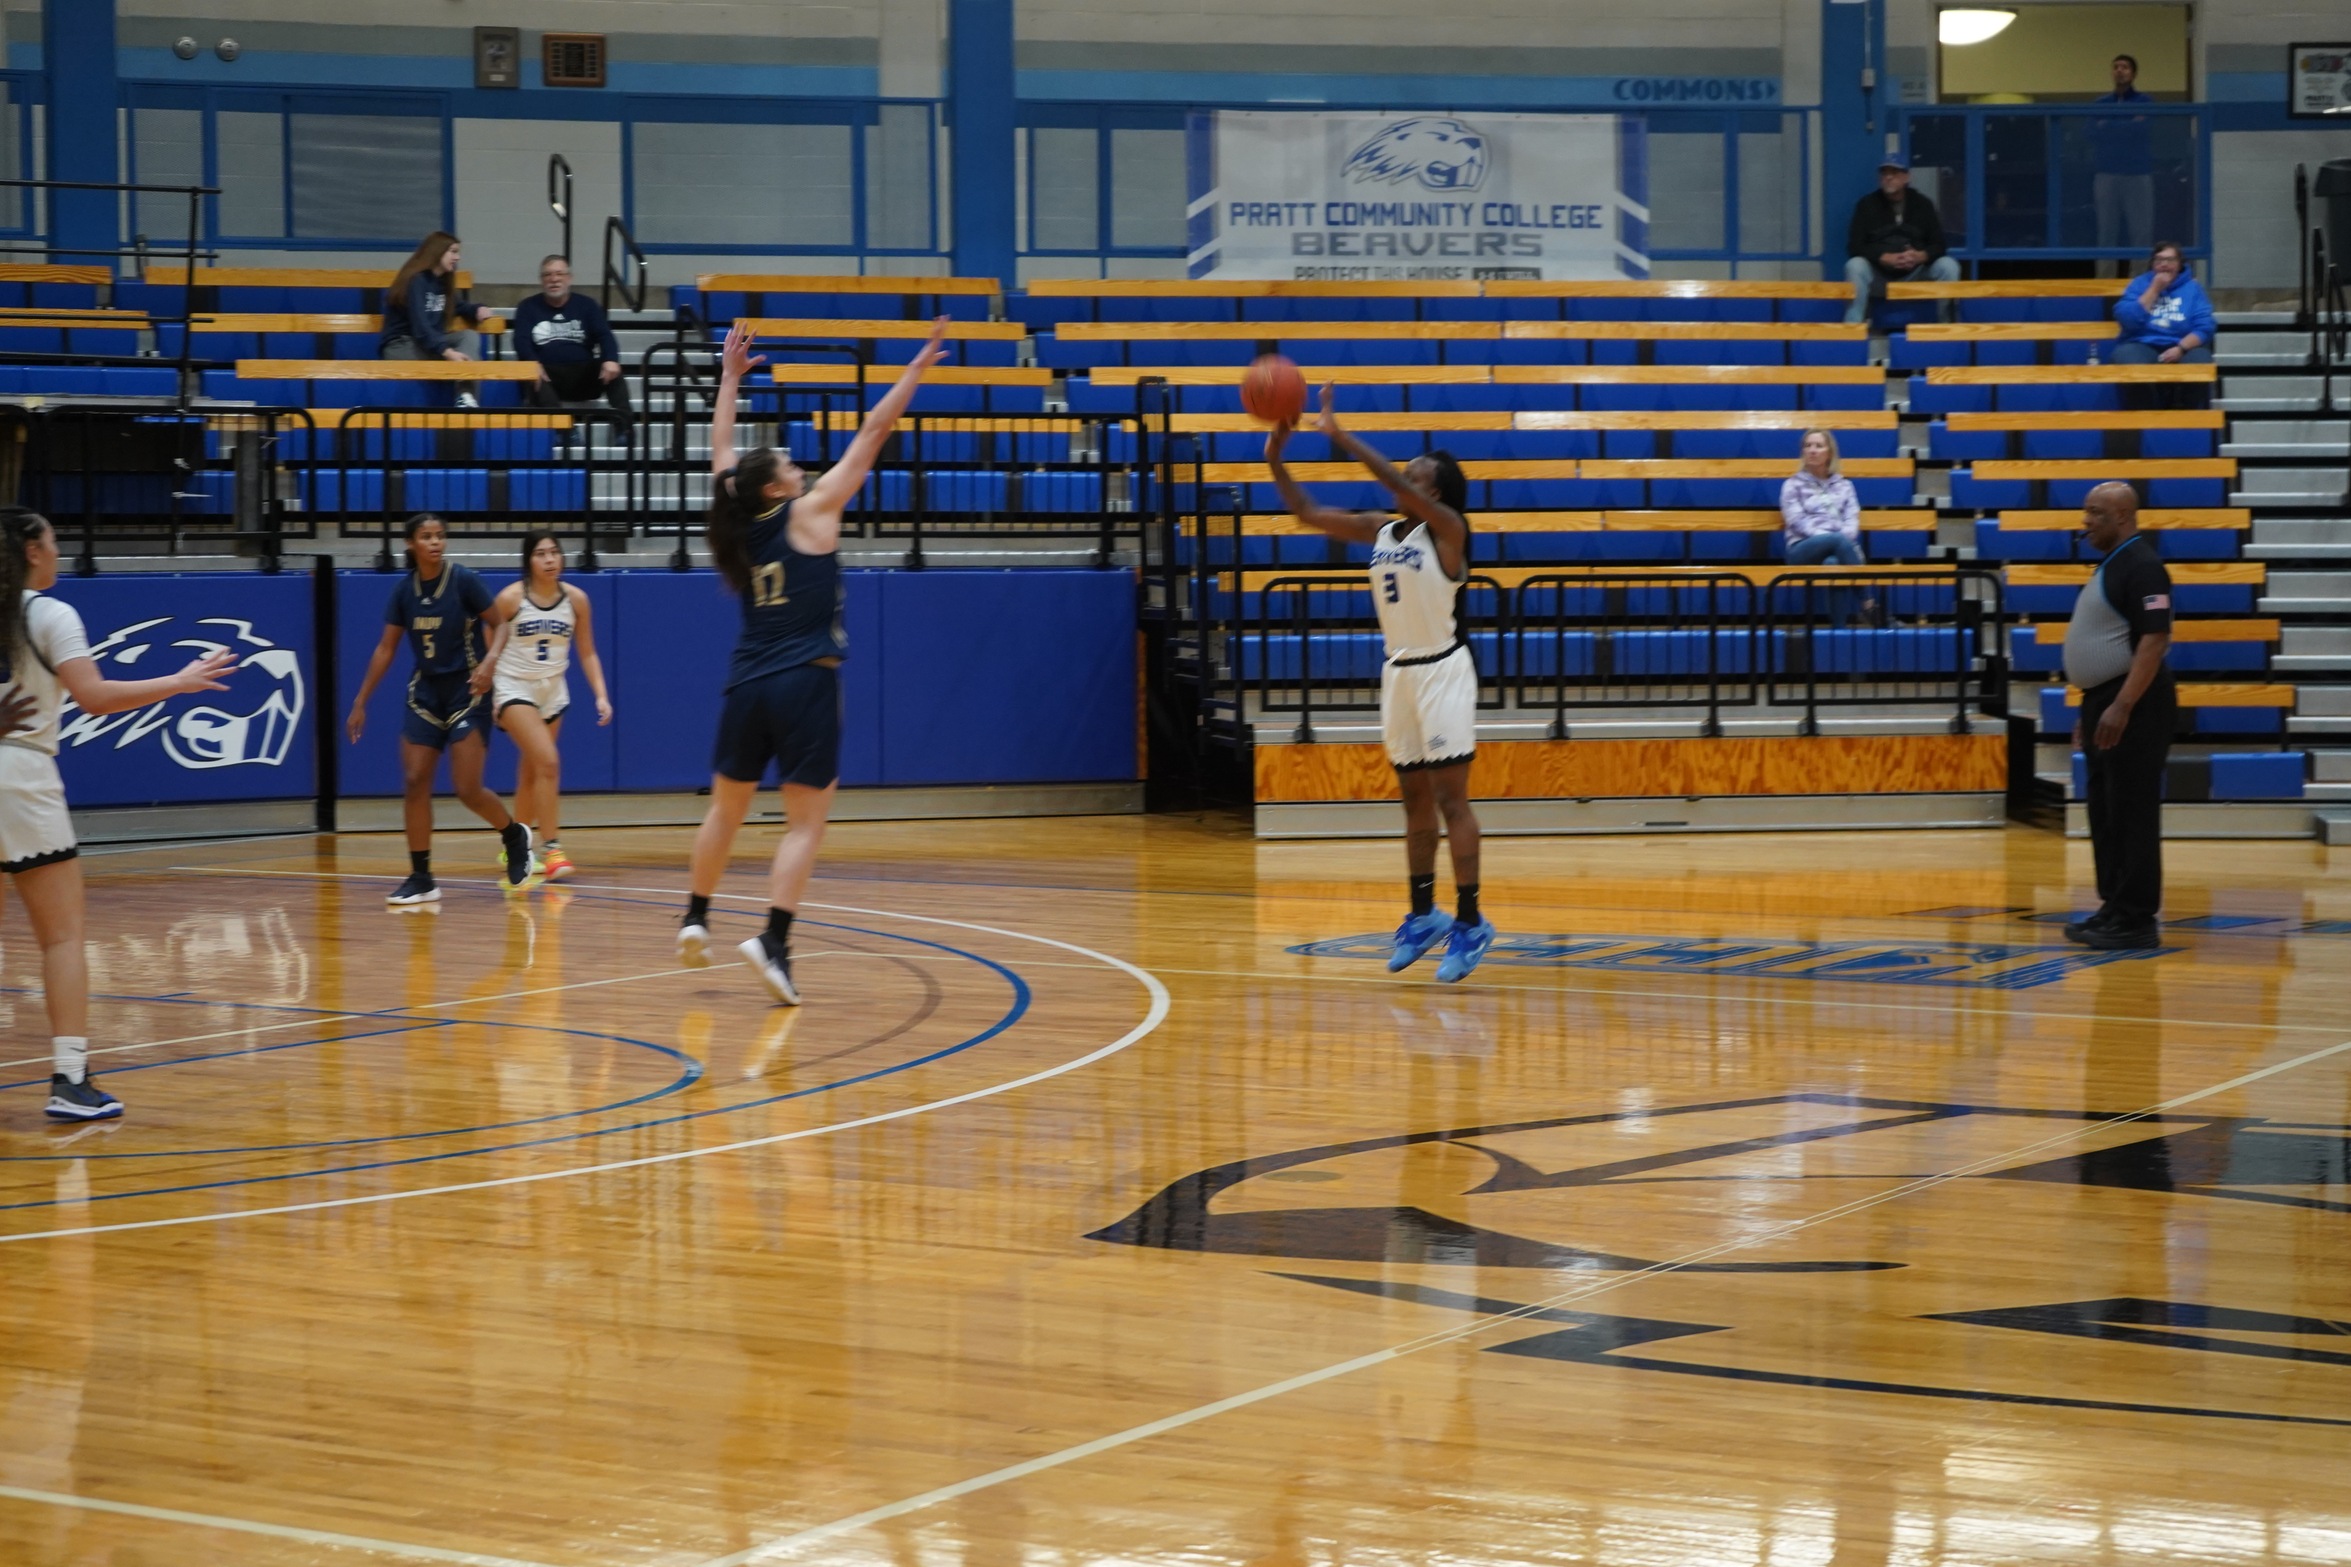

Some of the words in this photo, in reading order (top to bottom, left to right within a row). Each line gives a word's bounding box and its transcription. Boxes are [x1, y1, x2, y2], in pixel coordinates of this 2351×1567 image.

[1612, 79, 1763, 101] COMMONS
[1230, 202, 1317, 227] PRATT
[1326, 202, 1473, 228] COMMUNITY
[1482, 203, 1603, 230] COLLEGE
[1291, 232, 1544, 258] BEAVERS
[1294, 266, 1368, 281] PROTECT
[1384, 573, 1399, 603] 3
[517, 618, 573, 638] BEAVERS
[422, 633, 436, 659] 5
[537, 638, 551, 661] 5
